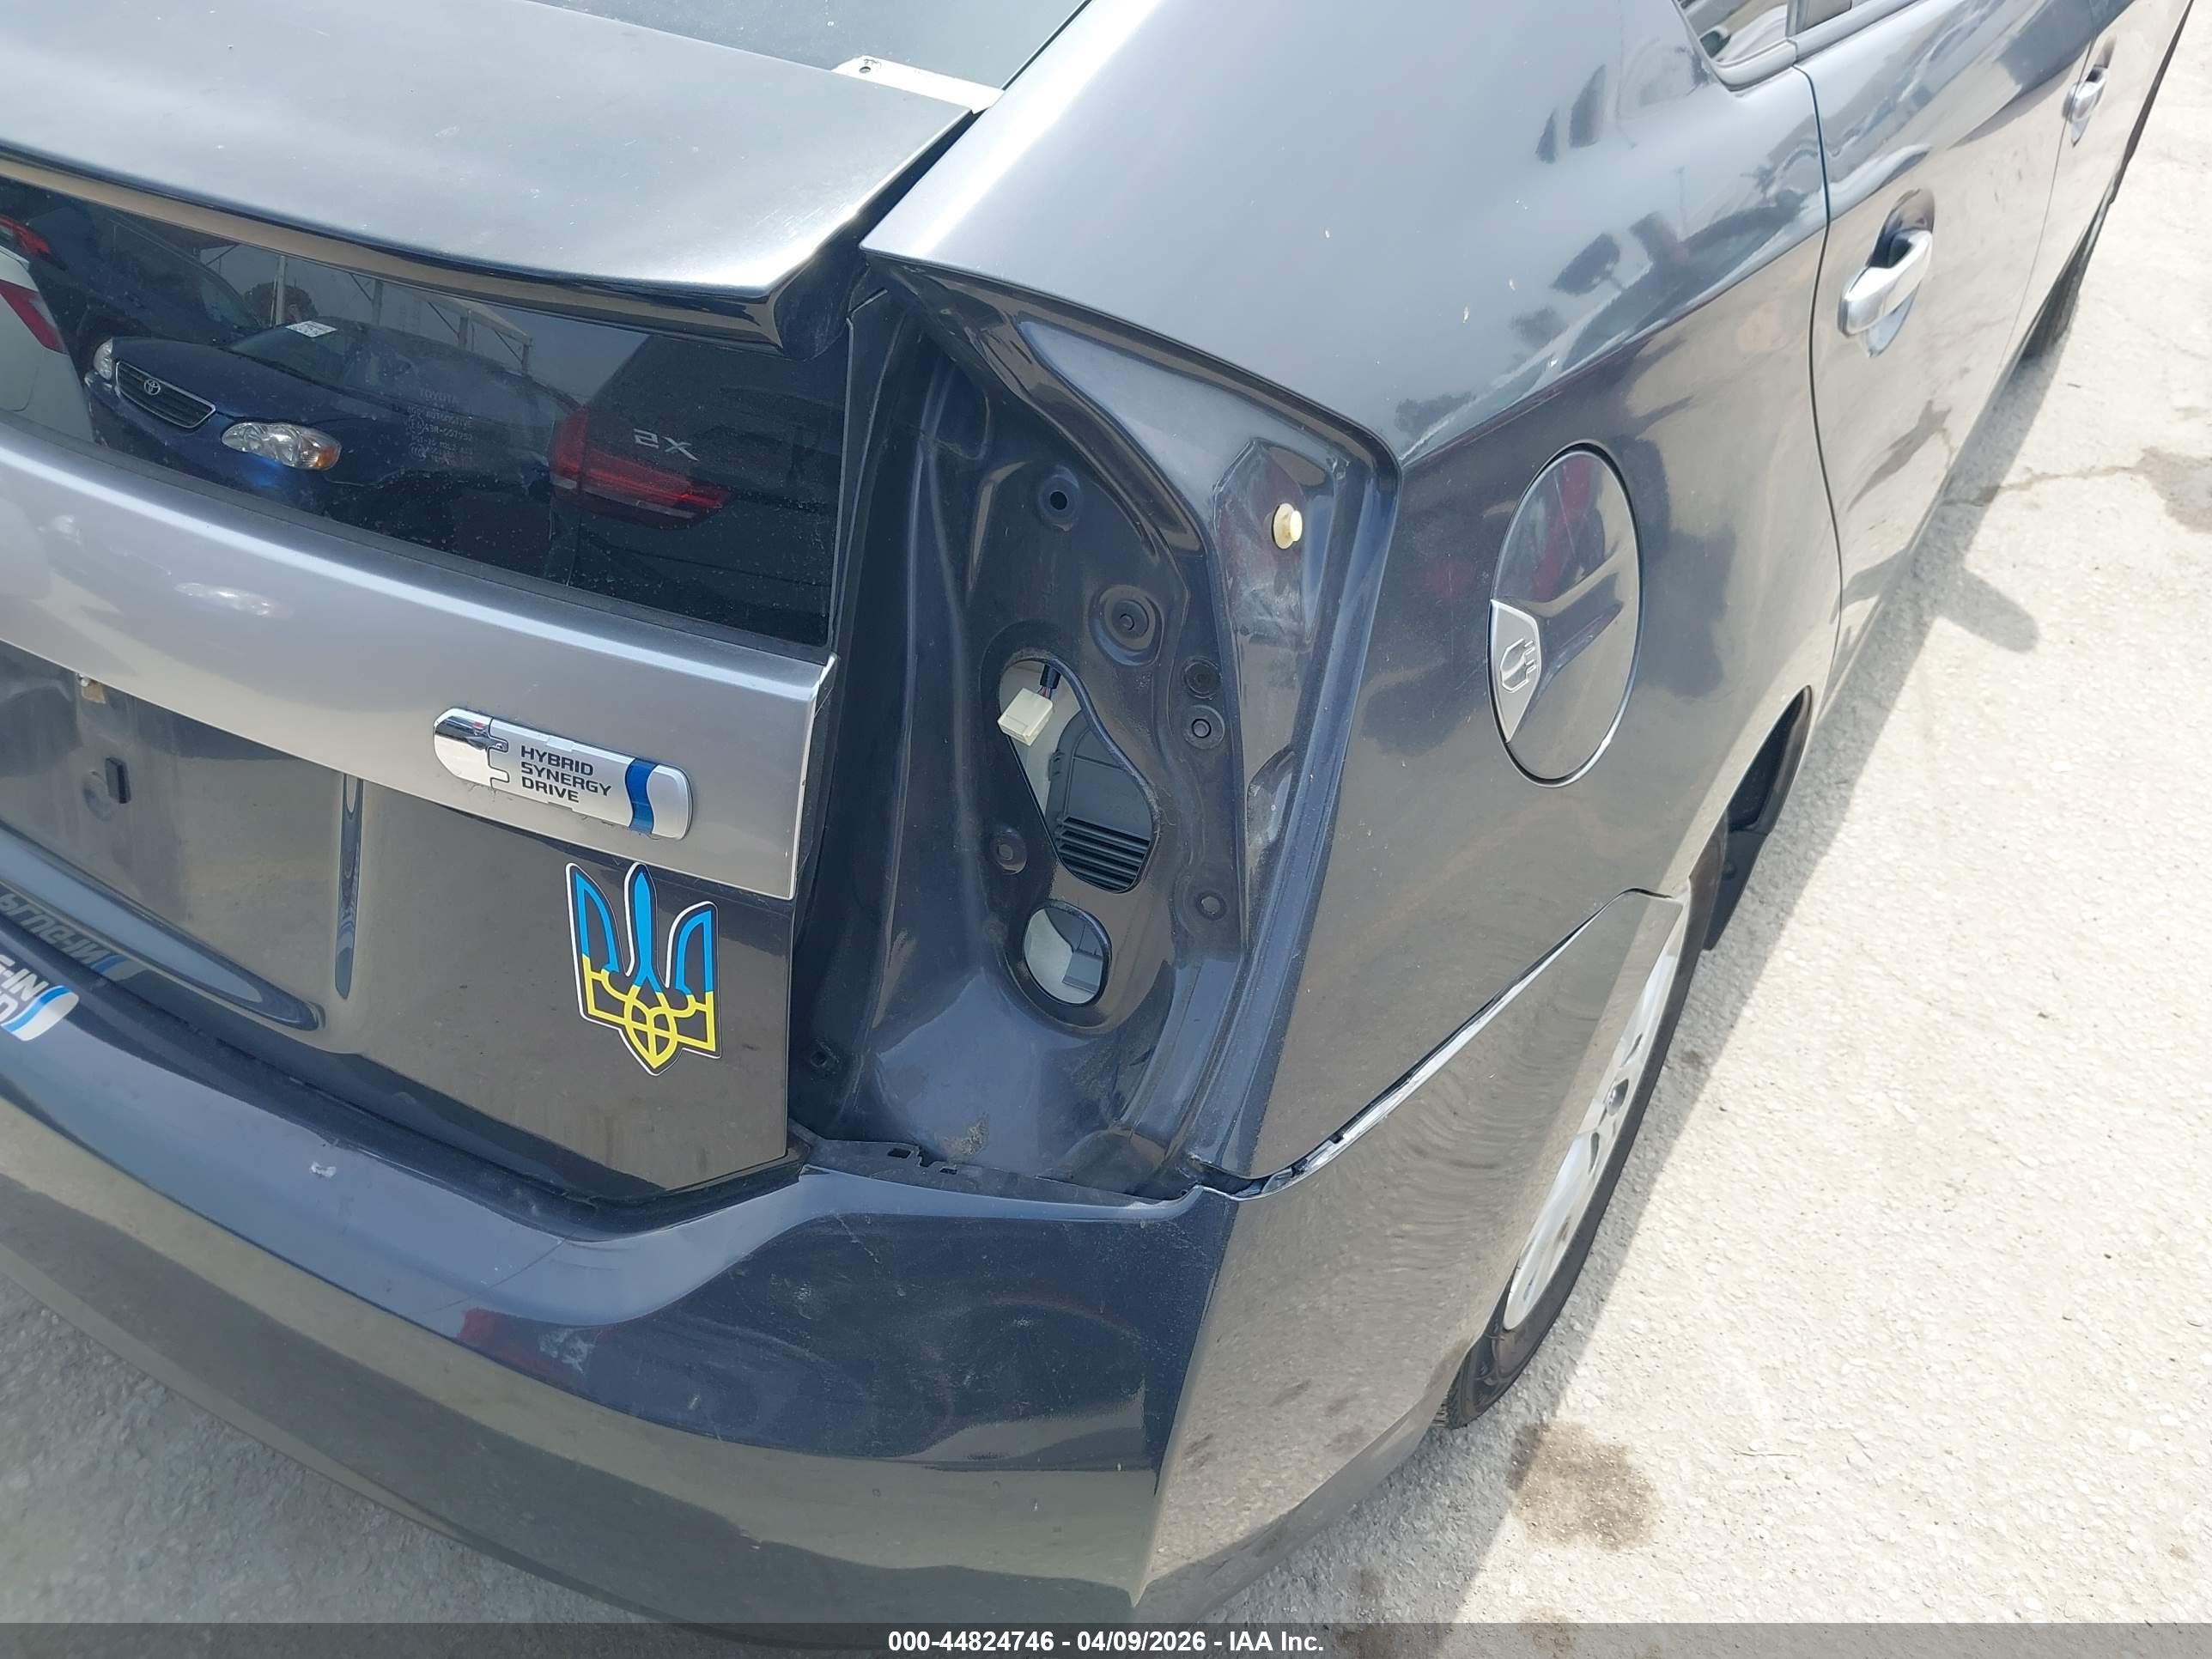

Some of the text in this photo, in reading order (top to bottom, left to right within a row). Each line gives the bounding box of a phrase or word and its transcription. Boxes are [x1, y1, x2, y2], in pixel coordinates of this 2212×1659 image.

[521, 744, 594, 776] HYBRID
[521, 761, 612, 797] SYNERGY
[521, 775, 580, 803] DRIVE
